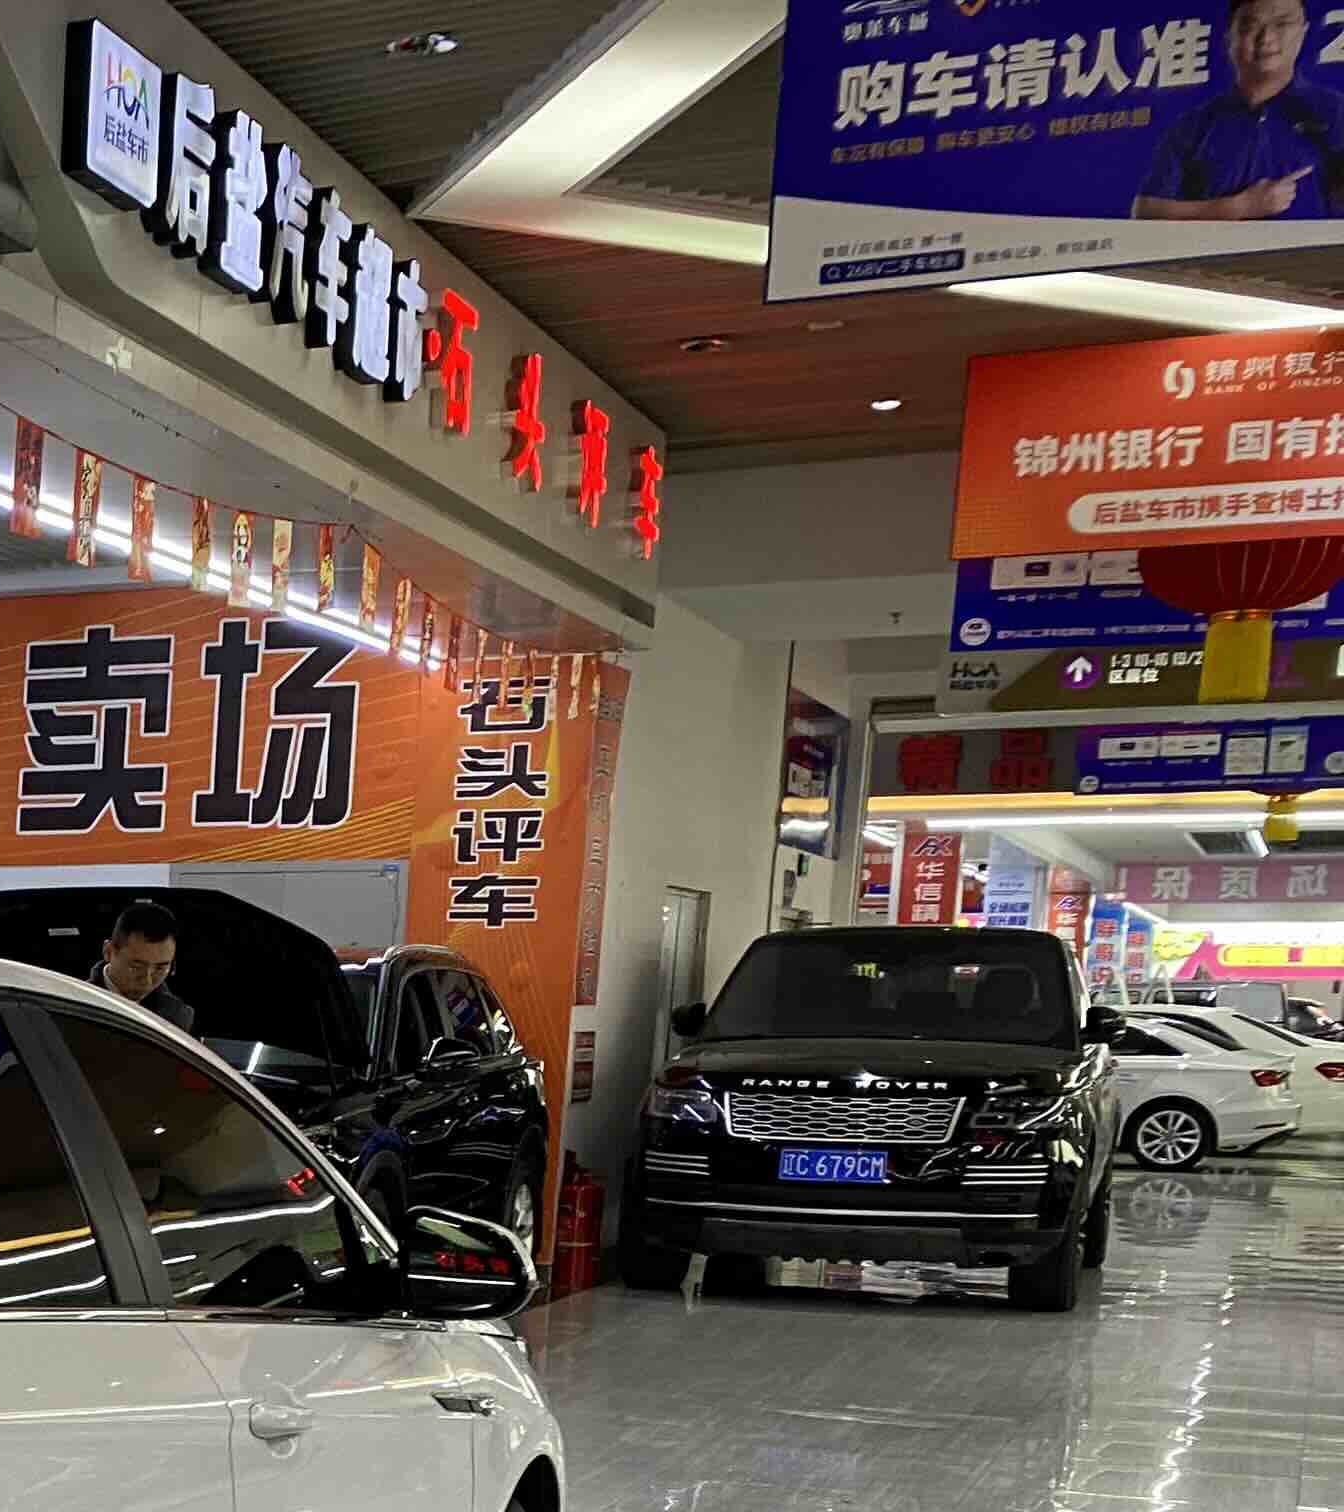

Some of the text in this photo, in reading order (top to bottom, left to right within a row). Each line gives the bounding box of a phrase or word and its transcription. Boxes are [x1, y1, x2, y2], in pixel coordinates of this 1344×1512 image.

[832, 18, 1210, 132] 购车请认准
[1204, 375, 1344, 395] BANK OF JINZHO
[1014, 424, 1204, 478] 锦州银行
[741, 1078, 949, 1091] RANGE ROVER
